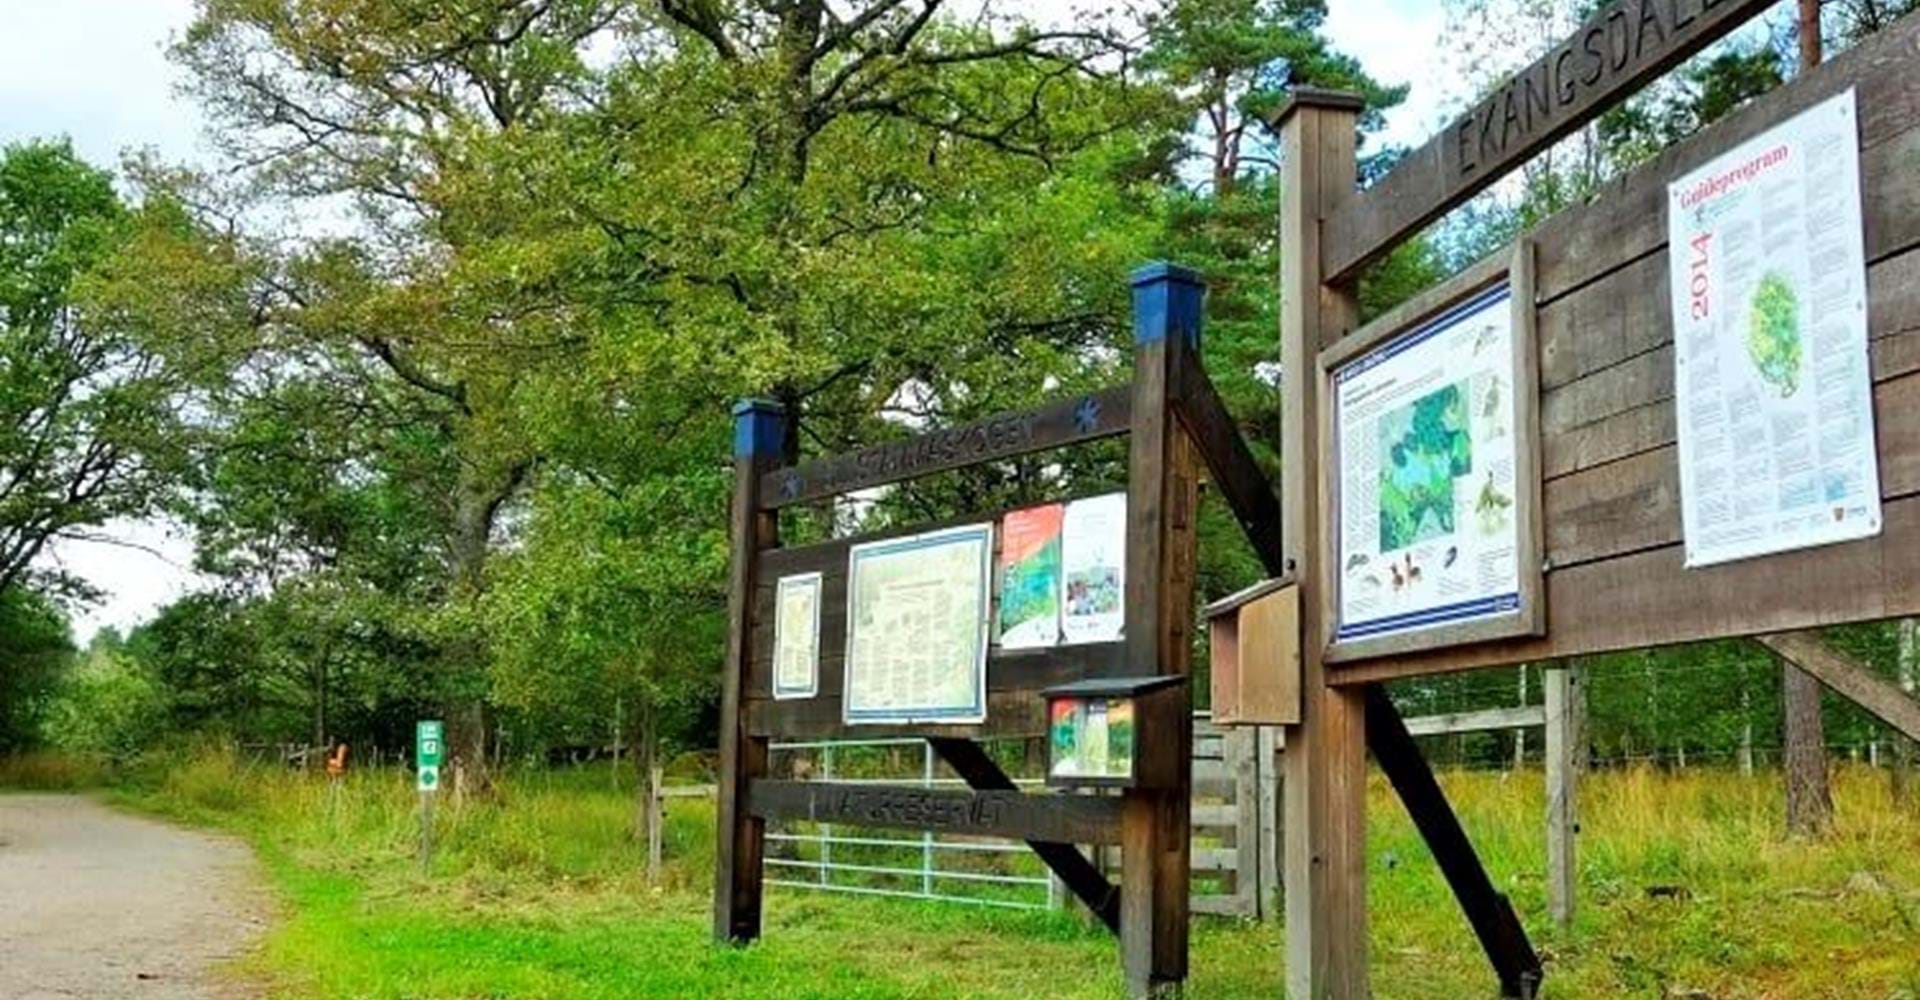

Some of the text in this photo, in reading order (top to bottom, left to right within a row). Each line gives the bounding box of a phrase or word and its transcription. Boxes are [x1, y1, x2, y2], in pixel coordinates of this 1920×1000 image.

[1457, 0, 1725, 173] EKÄNGSDAL
[1680, 144, 1788, 209] Guideprogram
[1691, 231, 1713, 321] 2014
